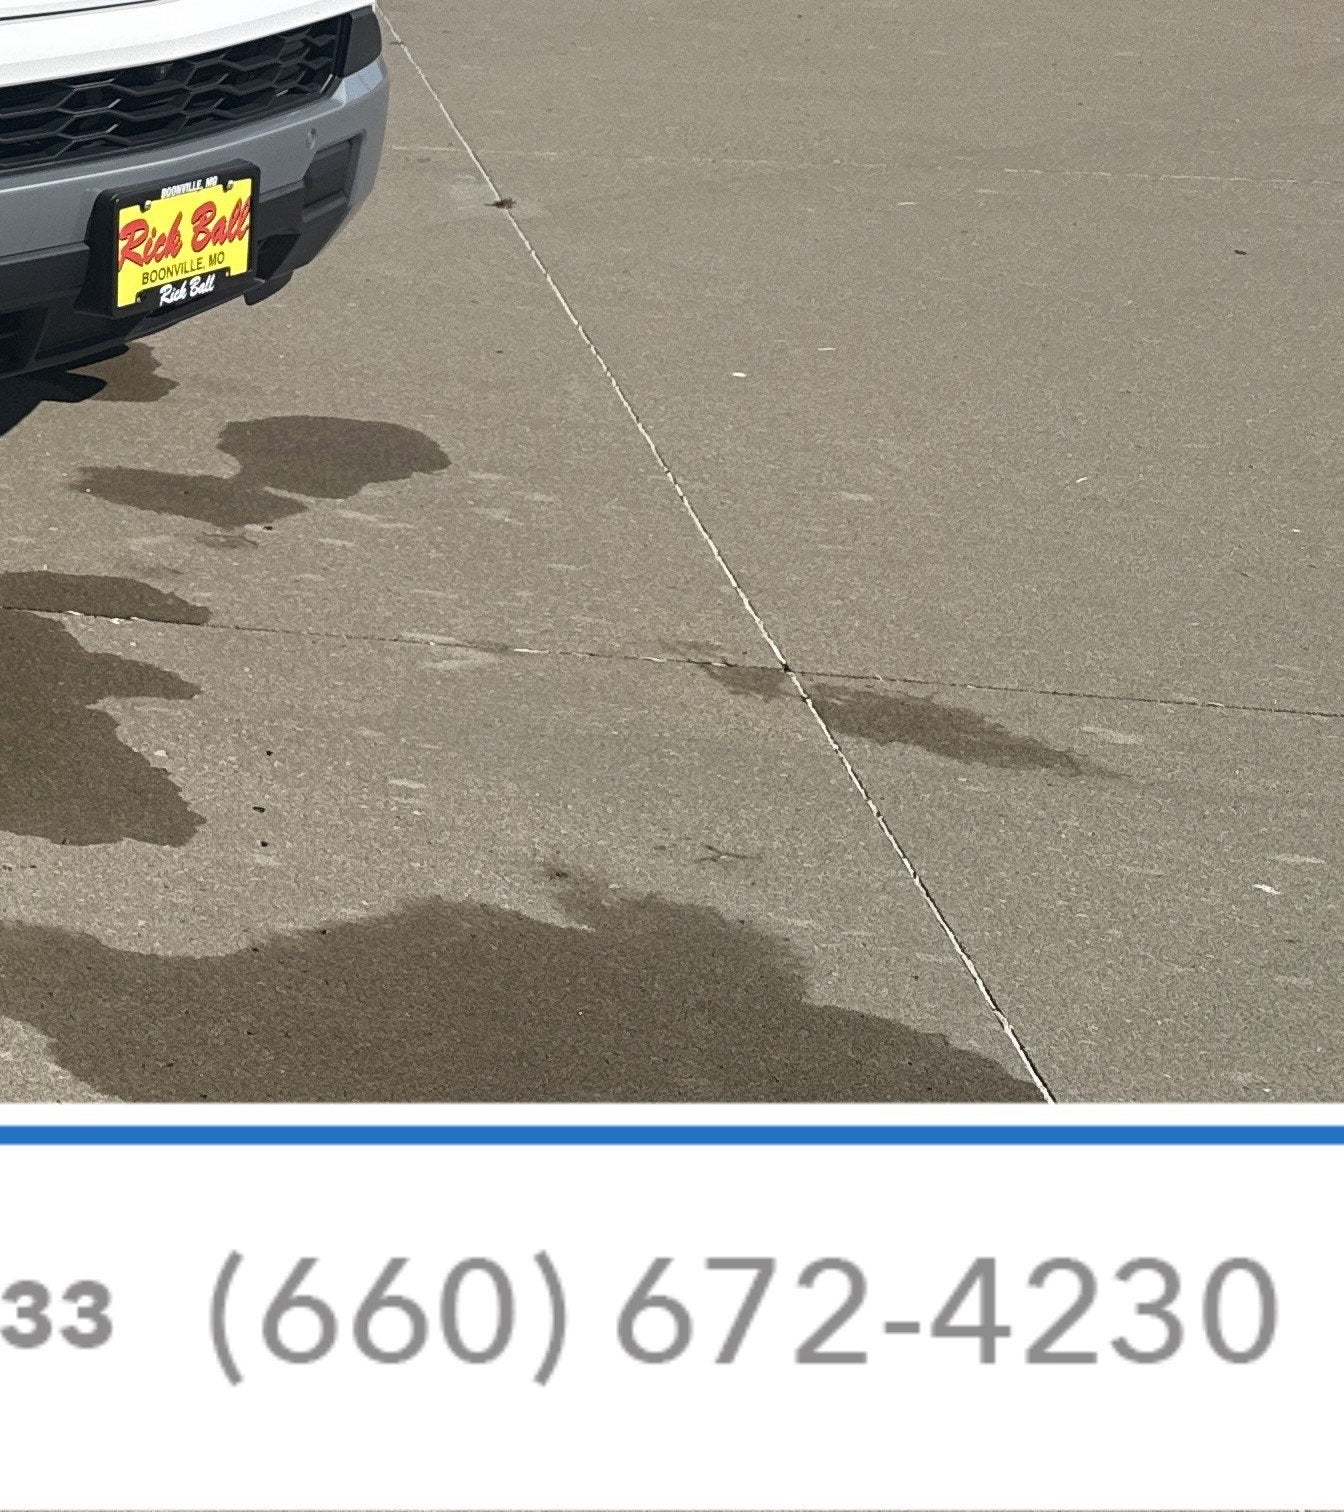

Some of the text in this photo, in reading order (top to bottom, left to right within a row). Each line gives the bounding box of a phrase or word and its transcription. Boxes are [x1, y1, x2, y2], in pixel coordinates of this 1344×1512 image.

[161, 176, 218, 199] BOONVILLE, MO
[119, 196, 252, 272] Rick Ball
[142, 251, 225, 285] BOONVILLE, MO
[159, 274, 216, 307] Rick Ball
